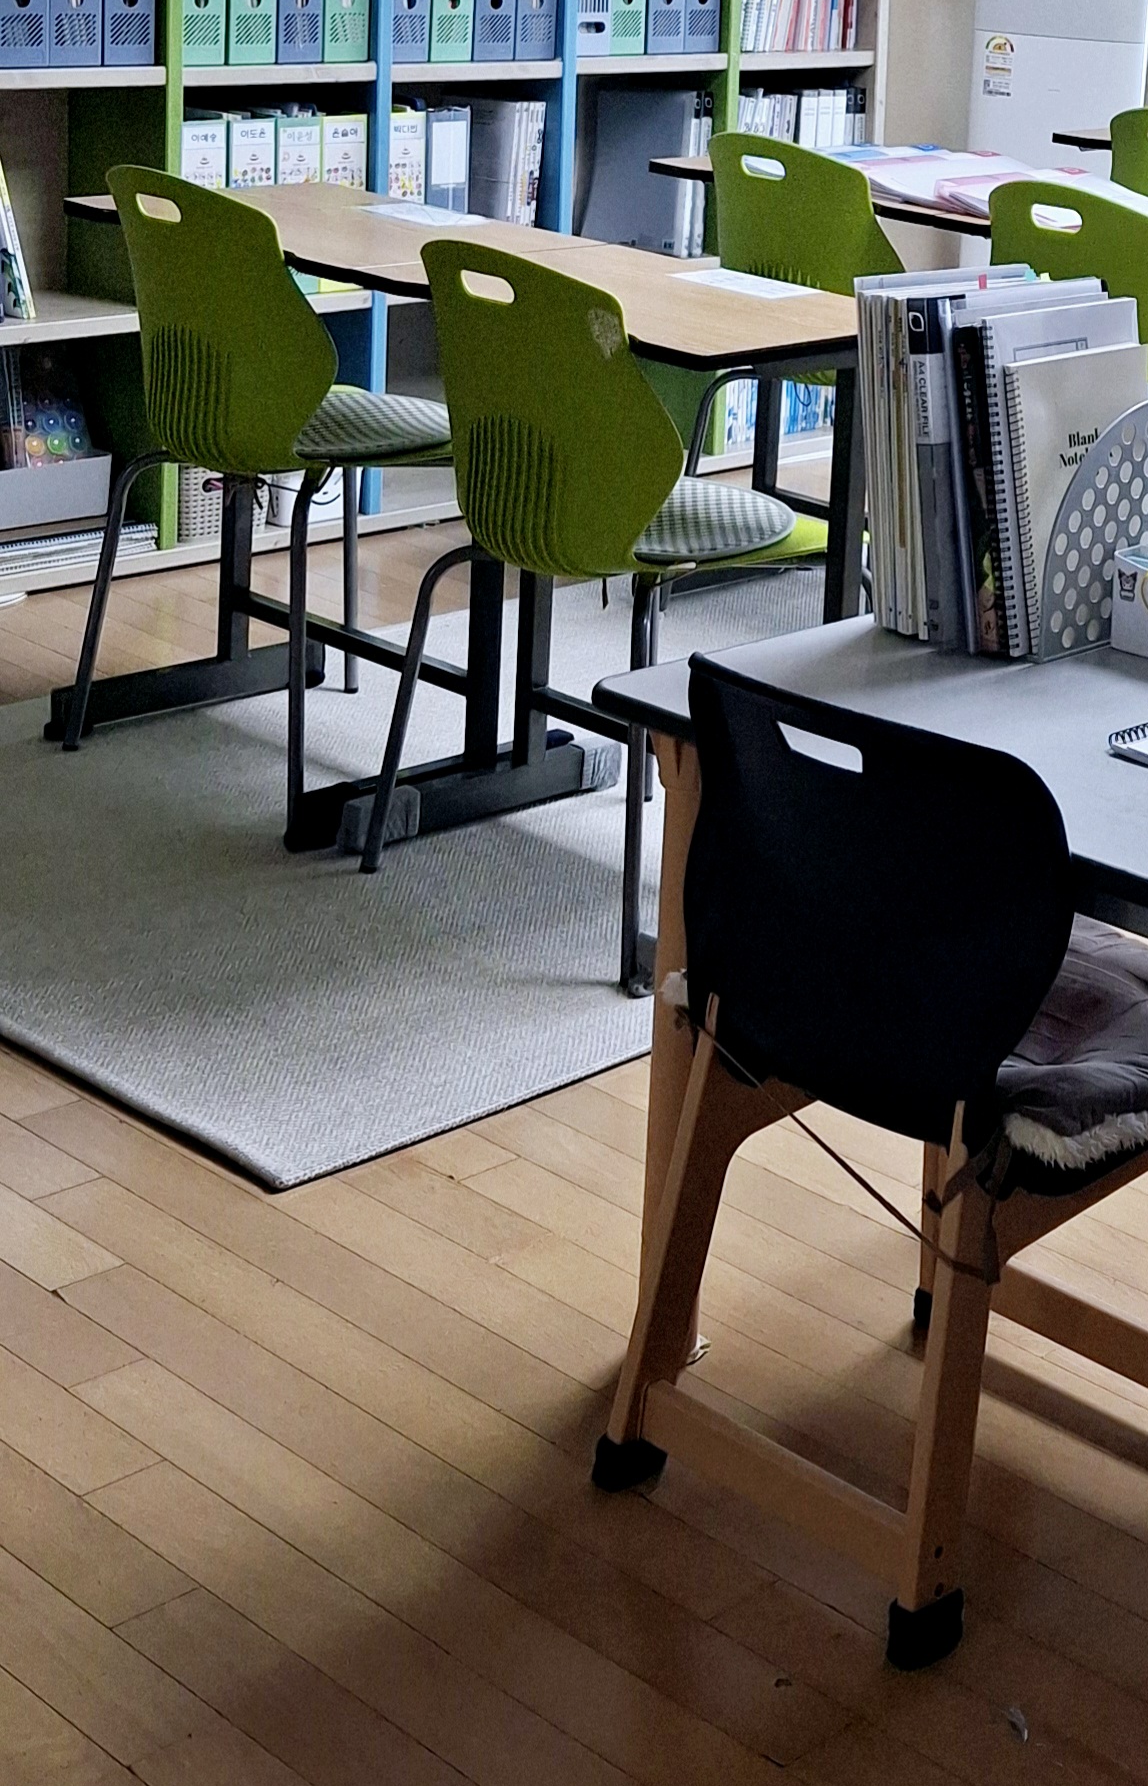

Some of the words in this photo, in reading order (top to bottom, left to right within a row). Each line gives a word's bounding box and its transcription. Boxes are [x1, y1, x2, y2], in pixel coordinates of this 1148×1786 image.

[917, 360, 925, 375] A4
[918, 377, 928, 413] CLEAR
[922, 415, 930, 437] FILE
